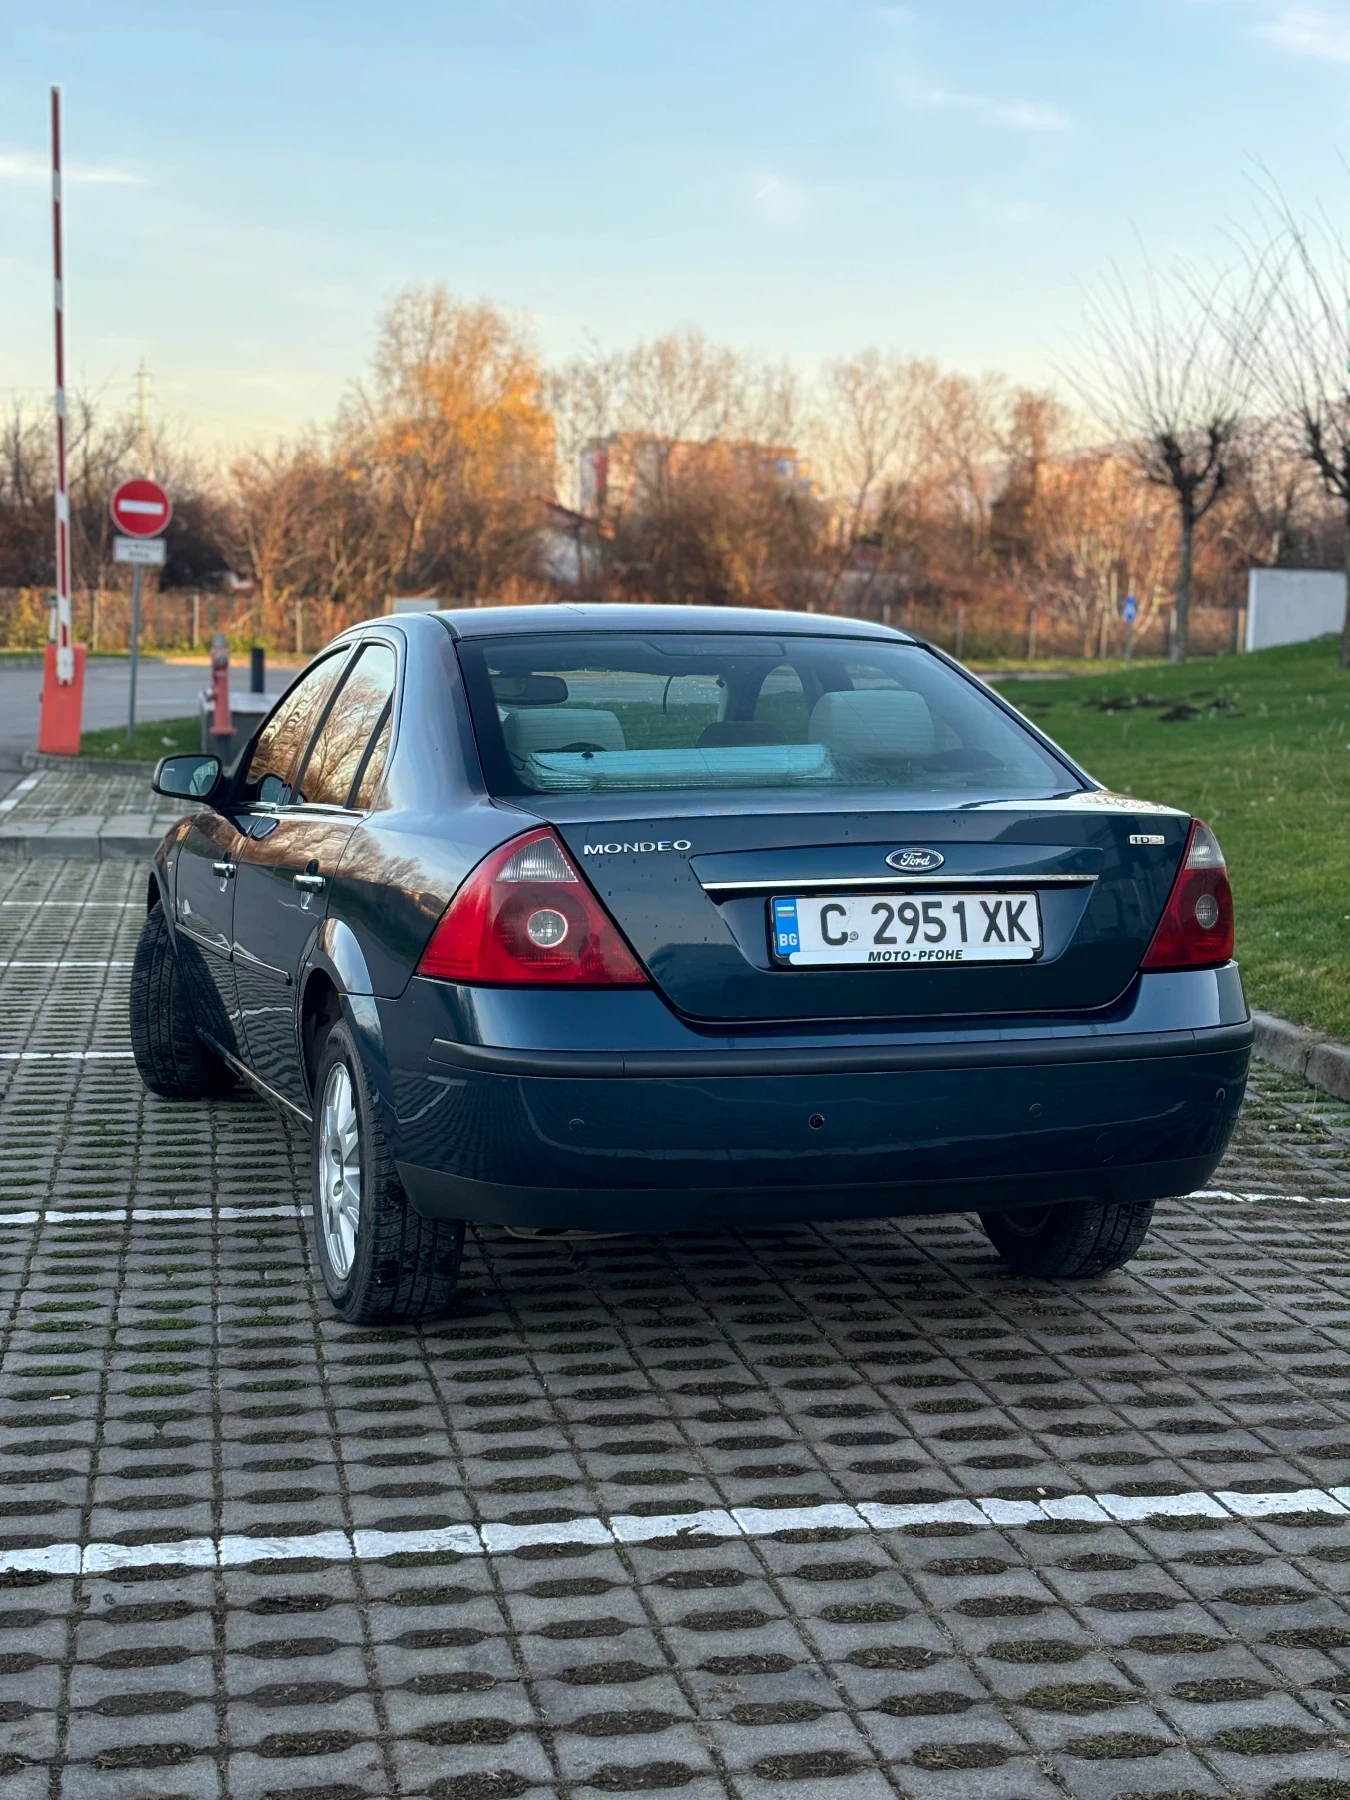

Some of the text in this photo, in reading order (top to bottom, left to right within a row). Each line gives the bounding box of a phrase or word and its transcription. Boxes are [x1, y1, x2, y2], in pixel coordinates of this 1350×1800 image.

[583, 840, 692, 855] MONDEO
[900, 852, 930, 865] Ford
[820, 900, 1032, 945] C 2951 XK
[780, 933, 797, 946] BG
